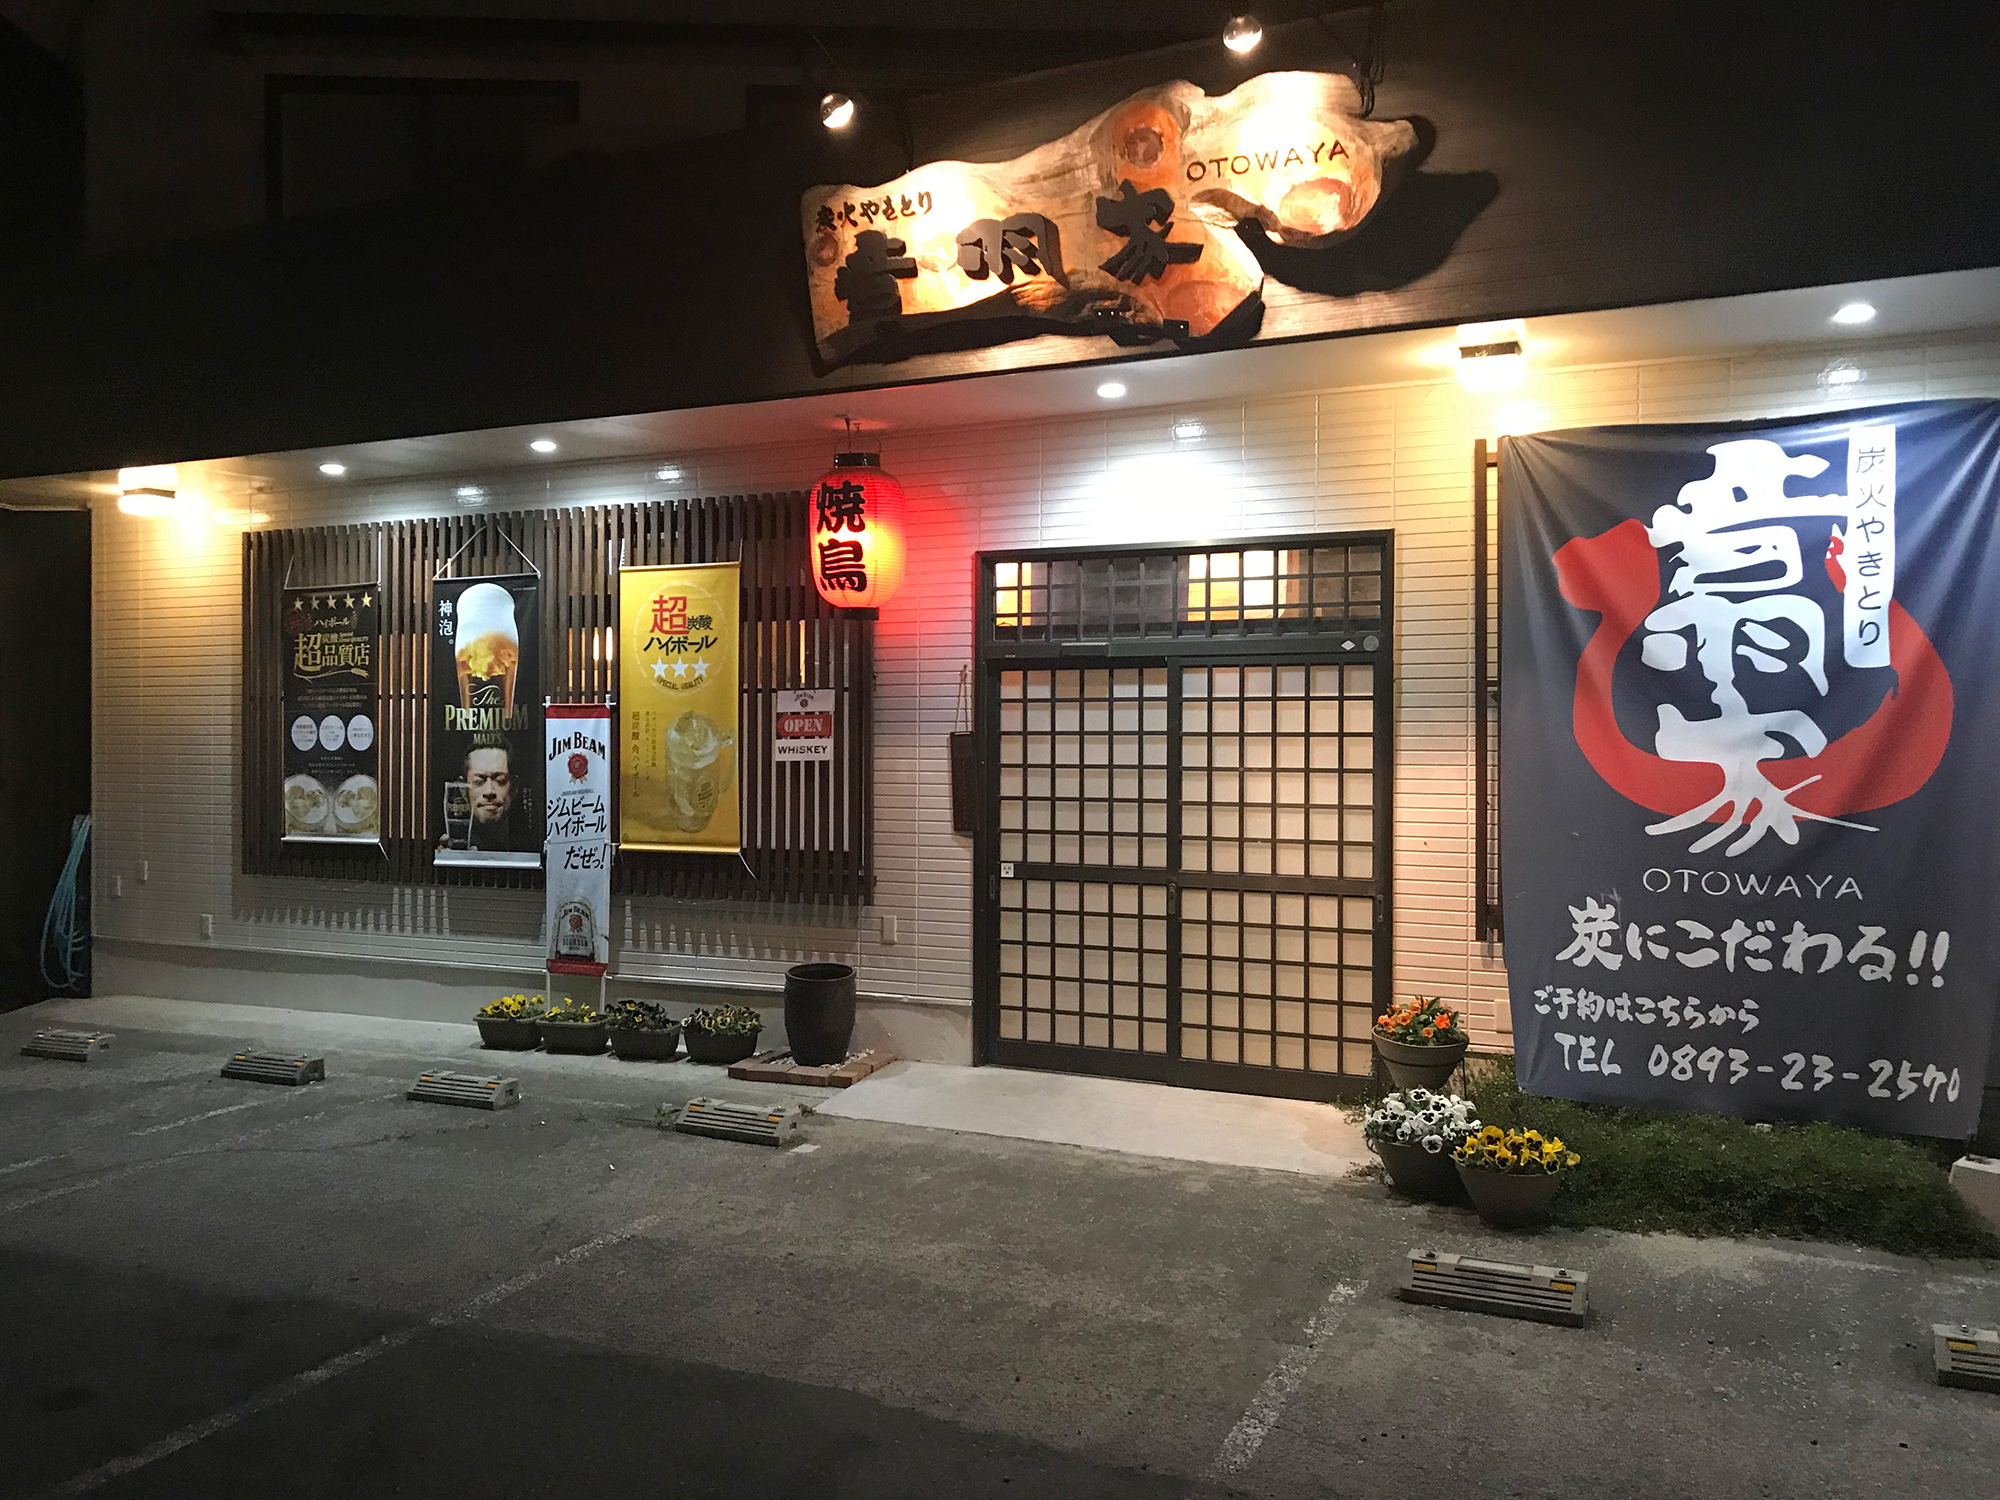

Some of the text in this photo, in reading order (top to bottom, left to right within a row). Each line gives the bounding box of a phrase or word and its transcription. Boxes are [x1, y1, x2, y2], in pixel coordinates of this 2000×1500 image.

[1186, 139, 1350, 182] OTOWAYA
[815, 191, 933, 233] 炭火やきとり
[816, 480, 868, 592] 焼鳥
[1855, 446, 1887, 647] 炭火やきとり
[311, 616, 351, 629] ハイボール
[438, 599, 455, 646] 神泡。
[642, 635, 718, 656] ハイボール
[466, 682, 502, 706] The
[444, 702, 530, 731] PREMIUM
[783, 718, 824, 733] OPEN
[548, 731, 606, 761] JIM BEAM
[547, 795, 605, 819] ジムビーム
[547, 814, 608, 838] ハイボール
[1642, 868, 1863, 900] OTOWAYA
[1533, 984, 1760, 1034] ご予約はこちらから
[1553, 1031, 1961, 1104] TEL 0893-23-2570
